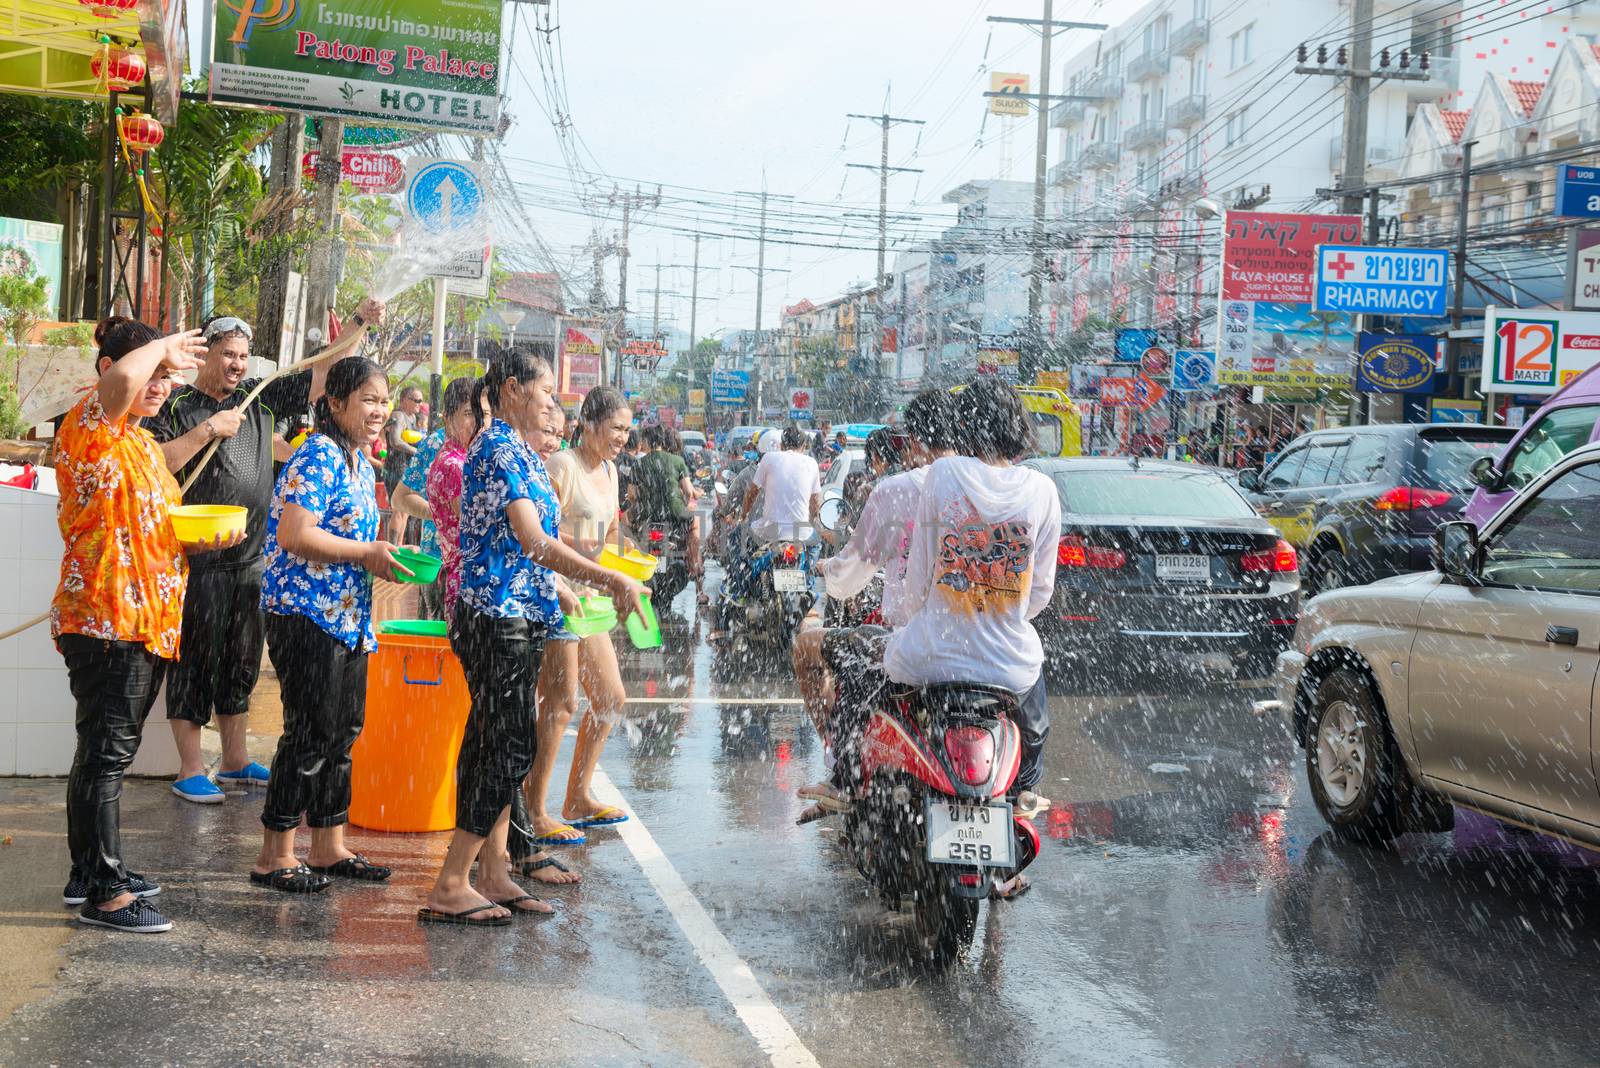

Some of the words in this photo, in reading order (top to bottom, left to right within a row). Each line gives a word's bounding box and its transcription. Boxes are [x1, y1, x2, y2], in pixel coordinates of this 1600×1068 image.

[294, 30, 396, 75] Patong
[403, 44, 496, 79] Palace
[219, 84, 318, 101] booking@patongpalace.com
[220, 76, 306, 92] www.patongpalace.com
[380, 88, 490, 121] HOTEL
[1577, 171, 1595, 179] UOB
[1230, 219, 1301, 248] קאיה
[1311, 223, 1359, 243] טדי
[1231, 271, 1263, 282] KAYA
[1267, 273, 1304, 284] HOUSE
[1365, 255, 1439, 283] ขายยา
[1325, 286, 1438, 309] PHARMACY
[1226, 324, 1248, 333] PADI
[1498, 321, 1553, 381] 12
[1369, 369, 1422, 385] MASSAGE
[1514, 370, 1549, 381] MART
[950, 711, 981, 719] HONDA
[949, 842, 992, 861] 258
